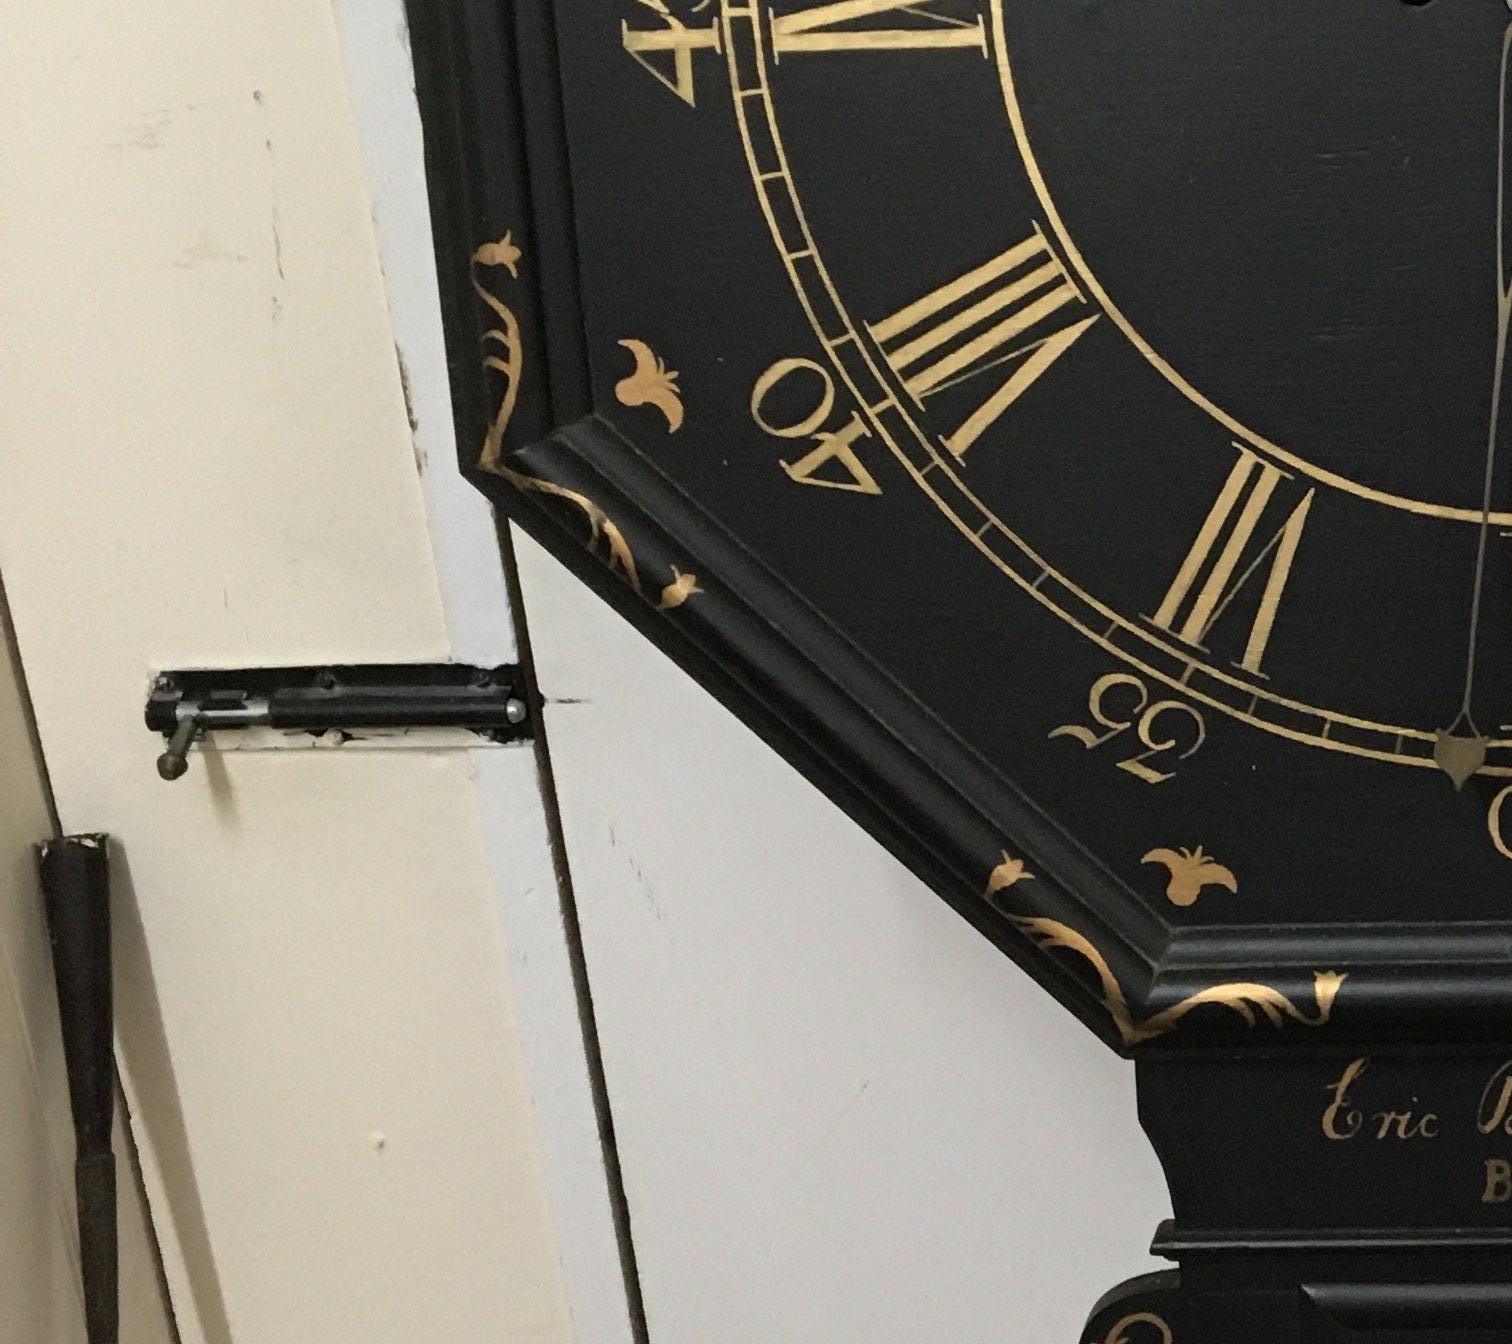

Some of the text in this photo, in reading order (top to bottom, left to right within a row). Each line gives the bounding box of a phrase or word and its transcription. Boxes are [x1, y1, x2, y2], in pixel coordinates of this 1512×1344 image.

[863, 219, 1100, 467] VIII
[750, 358, 882, 494] 40
[1139, 441, 1315, 679] VII
[1048, 673, 1205, 784] 35
[1321, 1057, 1439, 1140] Eric
